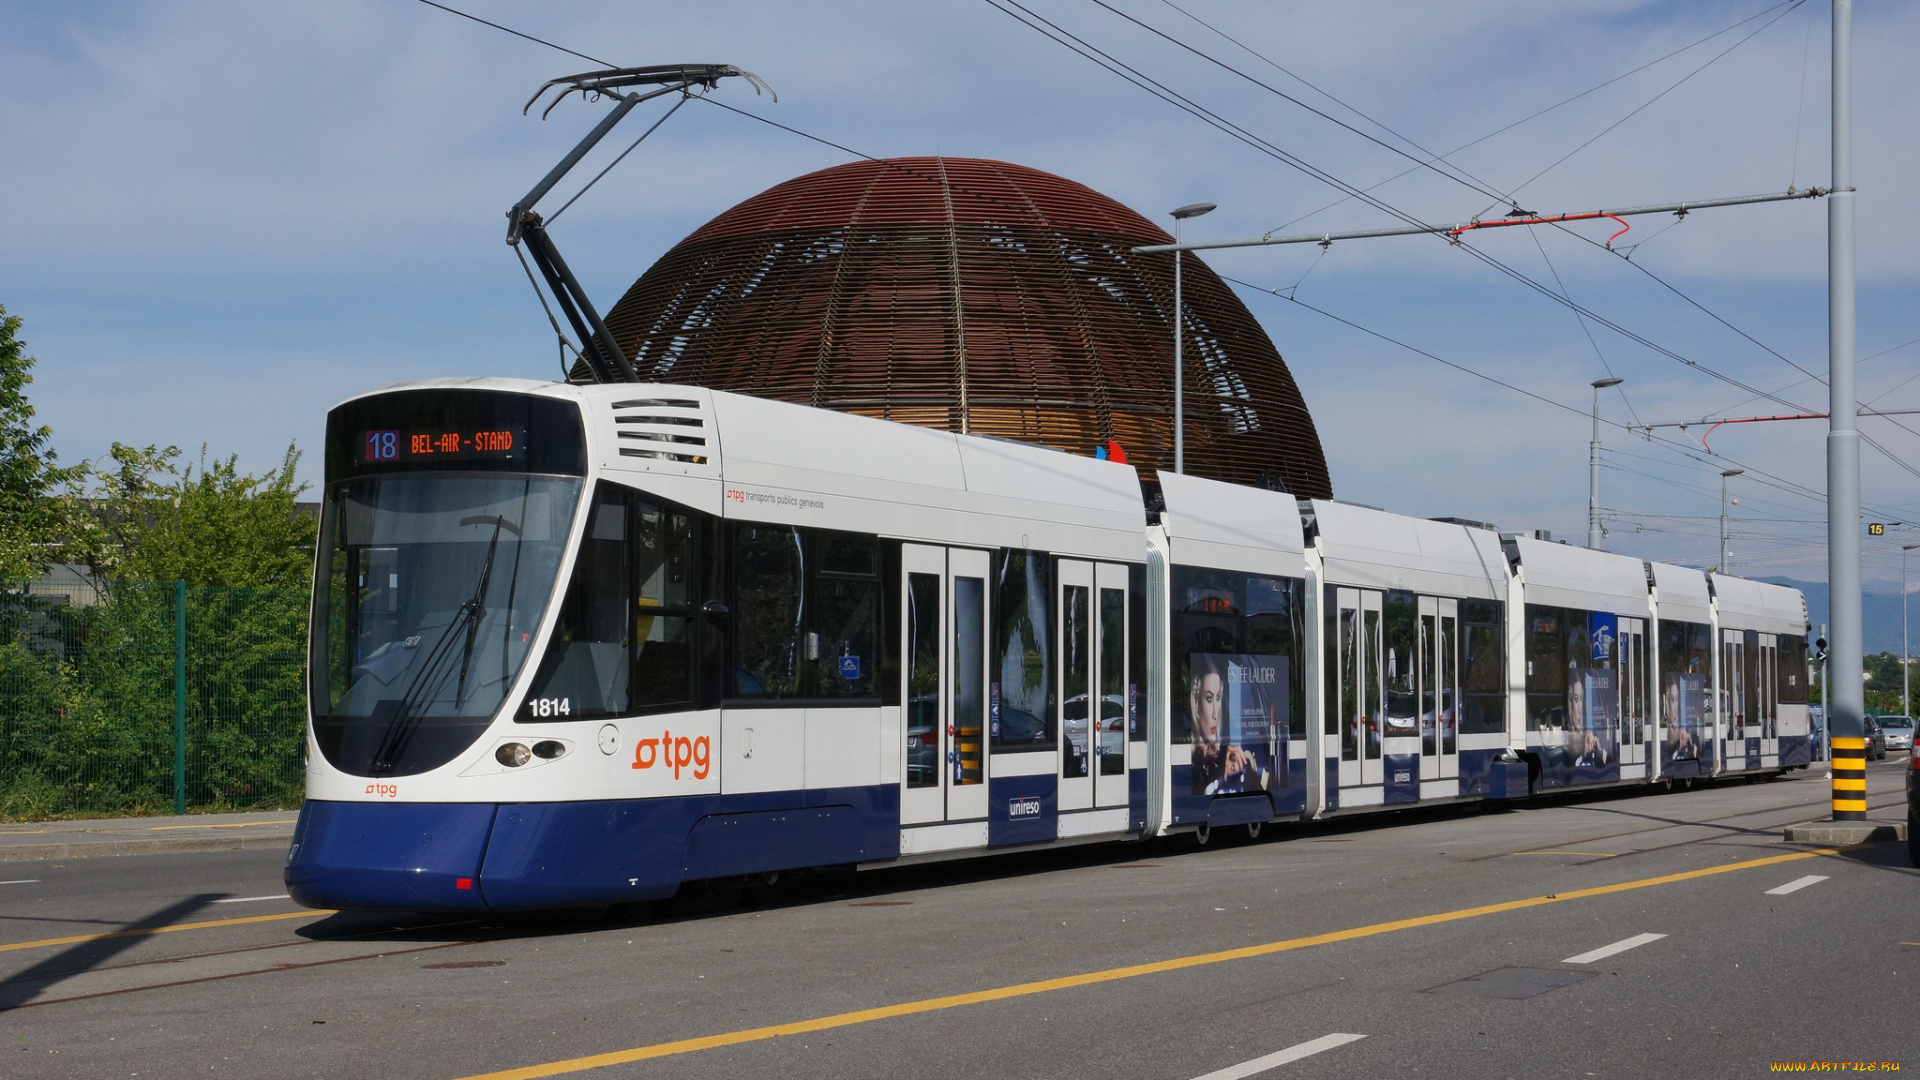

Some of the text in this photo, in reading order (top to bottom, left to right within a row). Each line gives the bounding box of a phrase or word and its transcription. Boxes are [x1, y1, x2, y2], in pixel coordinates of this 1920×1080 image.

[368, 432, 396, 459] 18
[411, 433, 460, 454] BEL-AIR
[475, 431, 513, 451] STAND
[746, 491, 775, 504] transports
[777, 494, 797, 506] publics
[799, 498, 824, 509] genevois
[1869, 524, 1883, 535] 15
[1227, 664, 1275, 684] ESTÉE LAUDER
[529, 697, 571, 717] 1814
[1010, 798, 1040, 816] unireso
